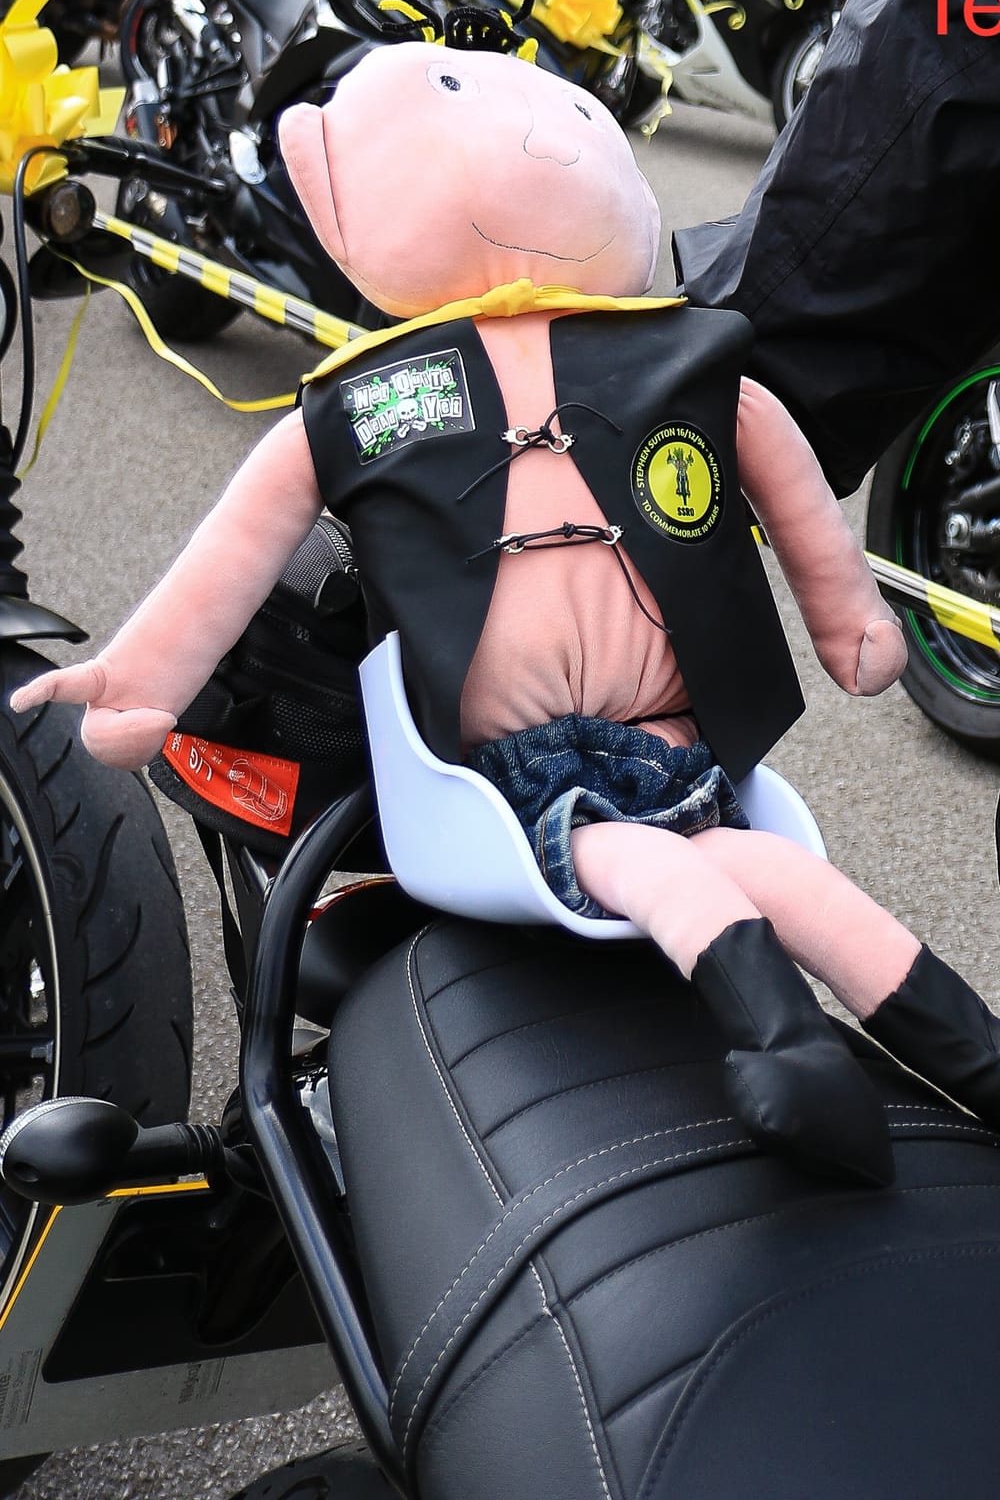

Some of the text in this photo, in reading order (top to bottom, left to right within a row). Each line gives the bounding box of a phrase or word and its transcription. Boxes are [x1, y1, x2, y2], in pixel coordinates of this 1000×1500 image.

[636, 446, 651, 488] STEPHEN
[647, 427, 676, 449] SUTTON
[676, 427, 706, 449] 16/12/94
[641, 499, 720, 538] TO COMMEMORATE 10 YEARS
[677, 506, 695, 517] SSRO
